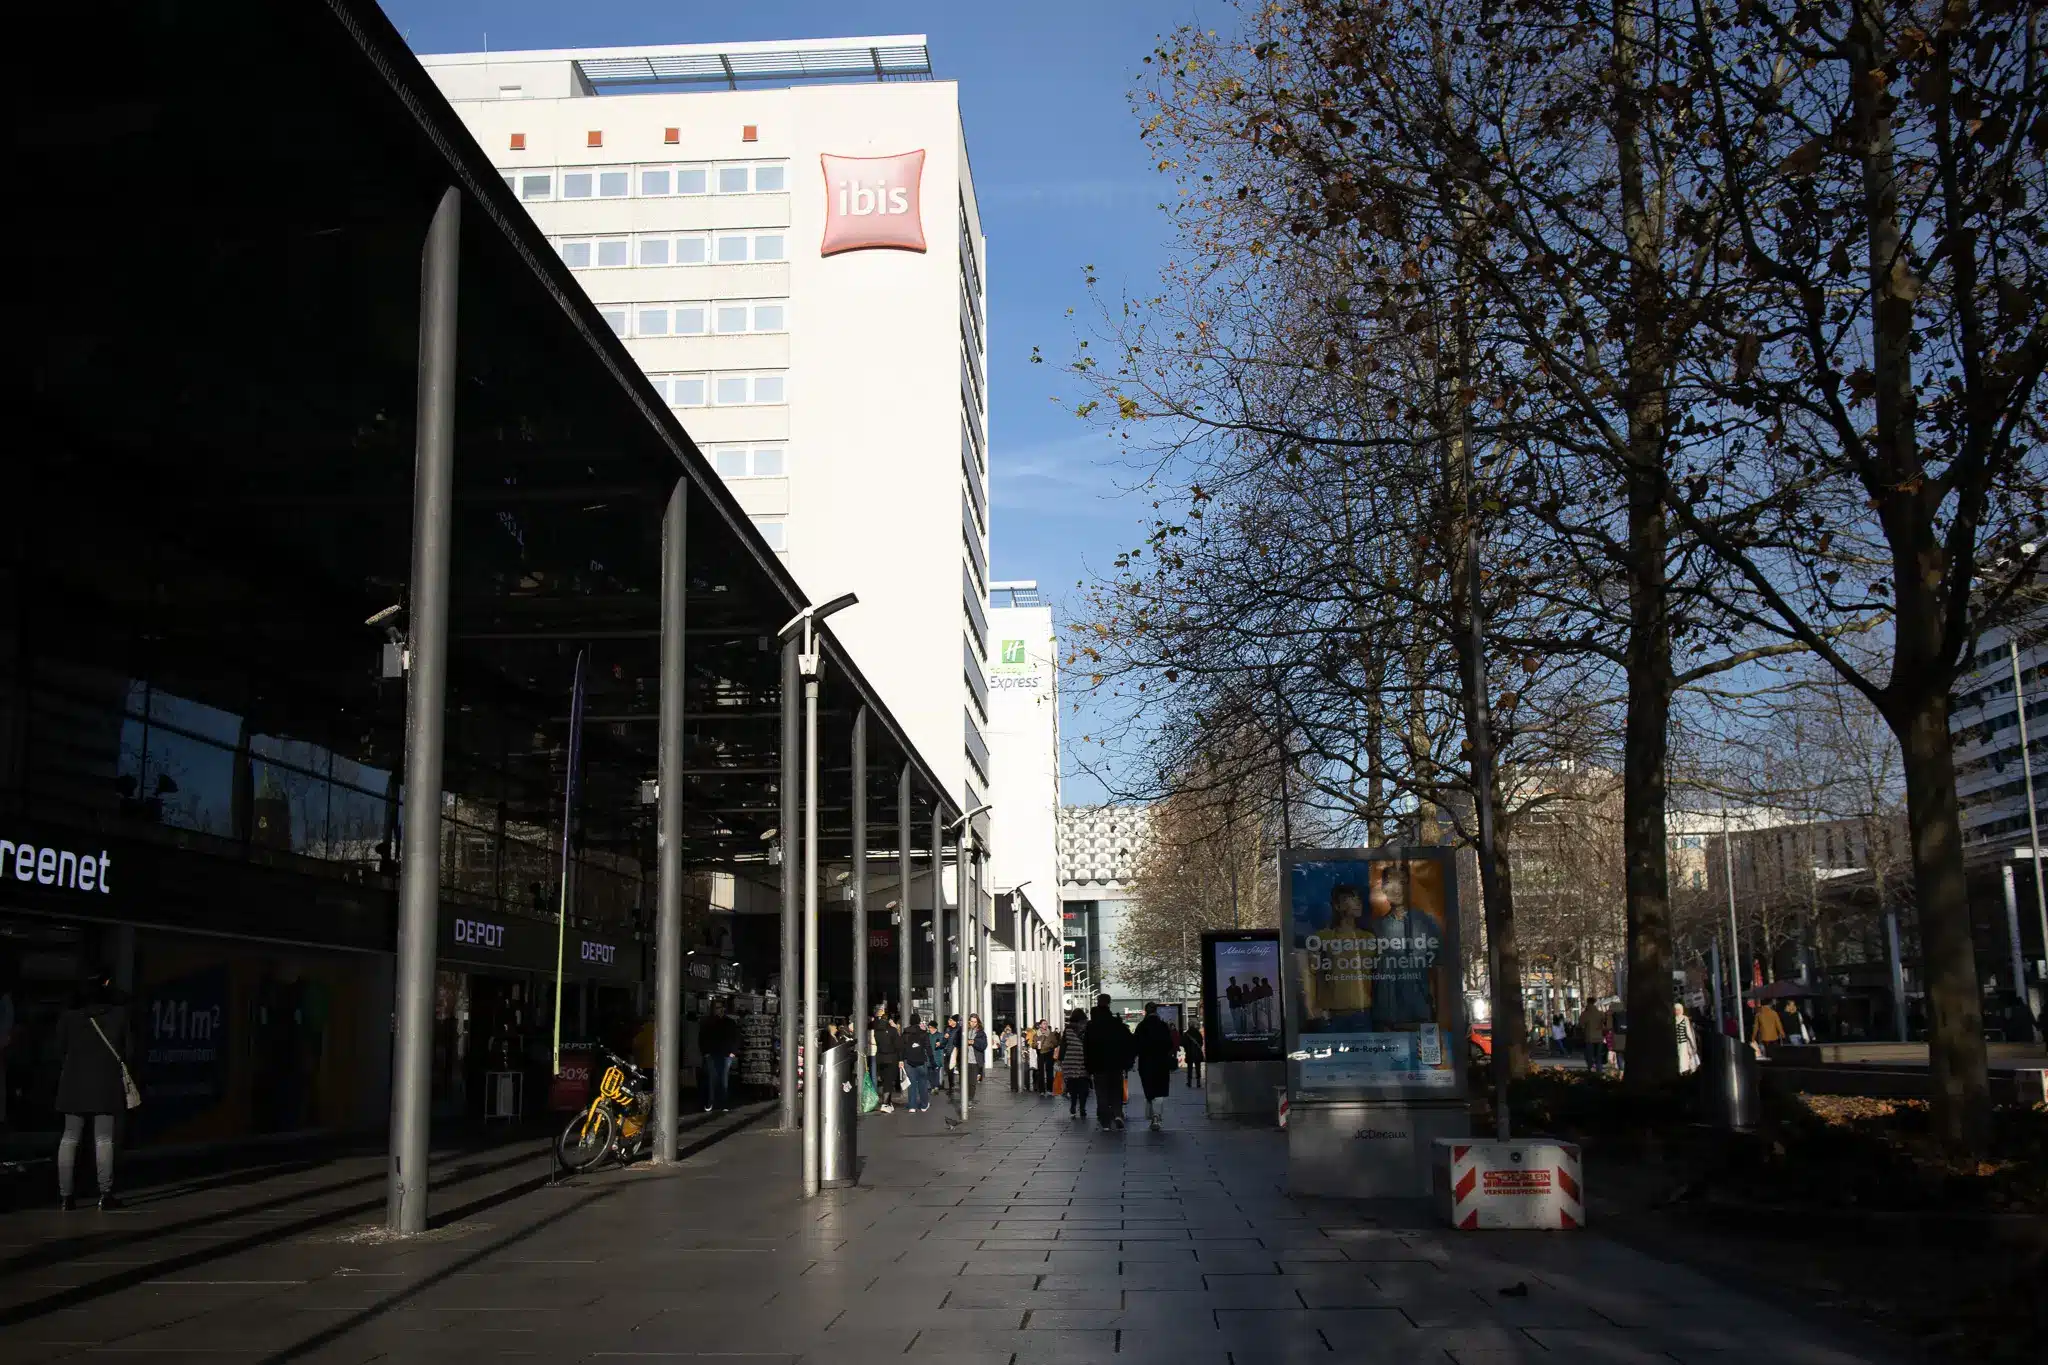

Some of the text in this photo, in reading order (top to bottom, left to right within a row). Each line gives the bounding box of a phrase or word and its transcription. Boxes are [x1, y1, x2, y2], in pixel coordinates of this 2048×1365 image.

[839, 180, 909, 216] ibis
[990, 676, 1038, 691] Express
[0, 839, 111, 894] reenet
[455, 918, 504, 948] DEPOT
[868, 936, 889, 948] ibis
[1305, 932, 1440, 954] Organspende
[580, 940, 616, 964] DEPOT
[1310, 951, 1436, 970] Ja oder nein?
[1325, 973, 1339, 981] Die
[1340, 972, 1396, 982] Entscheidung
[1354, 1129, 1408, 1140] JCDecaux
